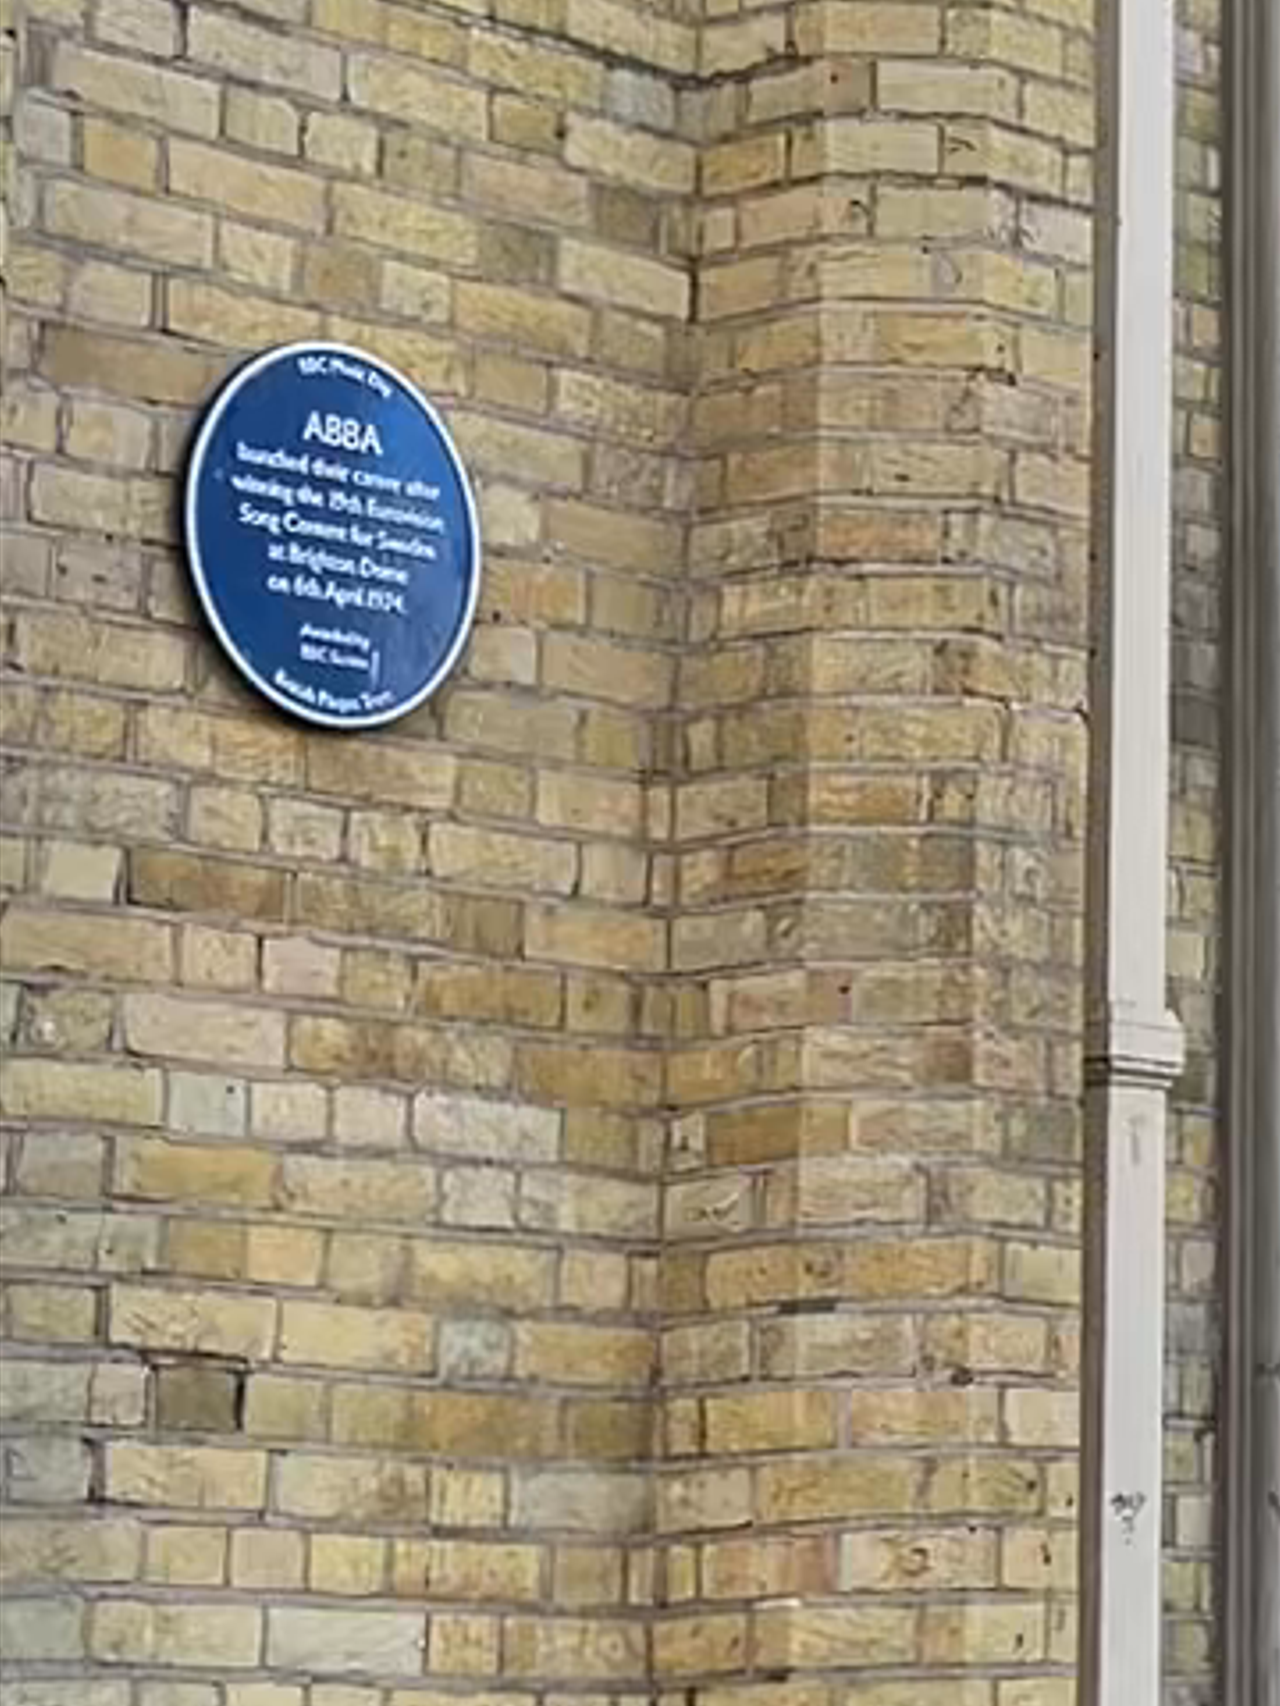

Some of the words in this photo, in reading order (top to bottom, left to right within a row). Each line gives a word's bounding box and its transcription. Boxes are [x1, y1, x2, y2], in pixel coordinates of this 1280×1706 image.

[303, 410, 383, 456] ABBA
[237, 441, 309, 475] launched
[312, 458, 349, 483] their
[405, 481, 440, 500] after
[231, 474, 293, 506] winning
[297, 485, 324, 507] the
[368, 498, 445, 536] Eurovision
[239, 502, 281, 535] Song
[351, 526, 372, 547] for
[289, 542, 355, 575] Brighton
[360, 556, 408, 585] Dome
[268, 574, 290, 594] on
[325, 580, 363, 611] April
